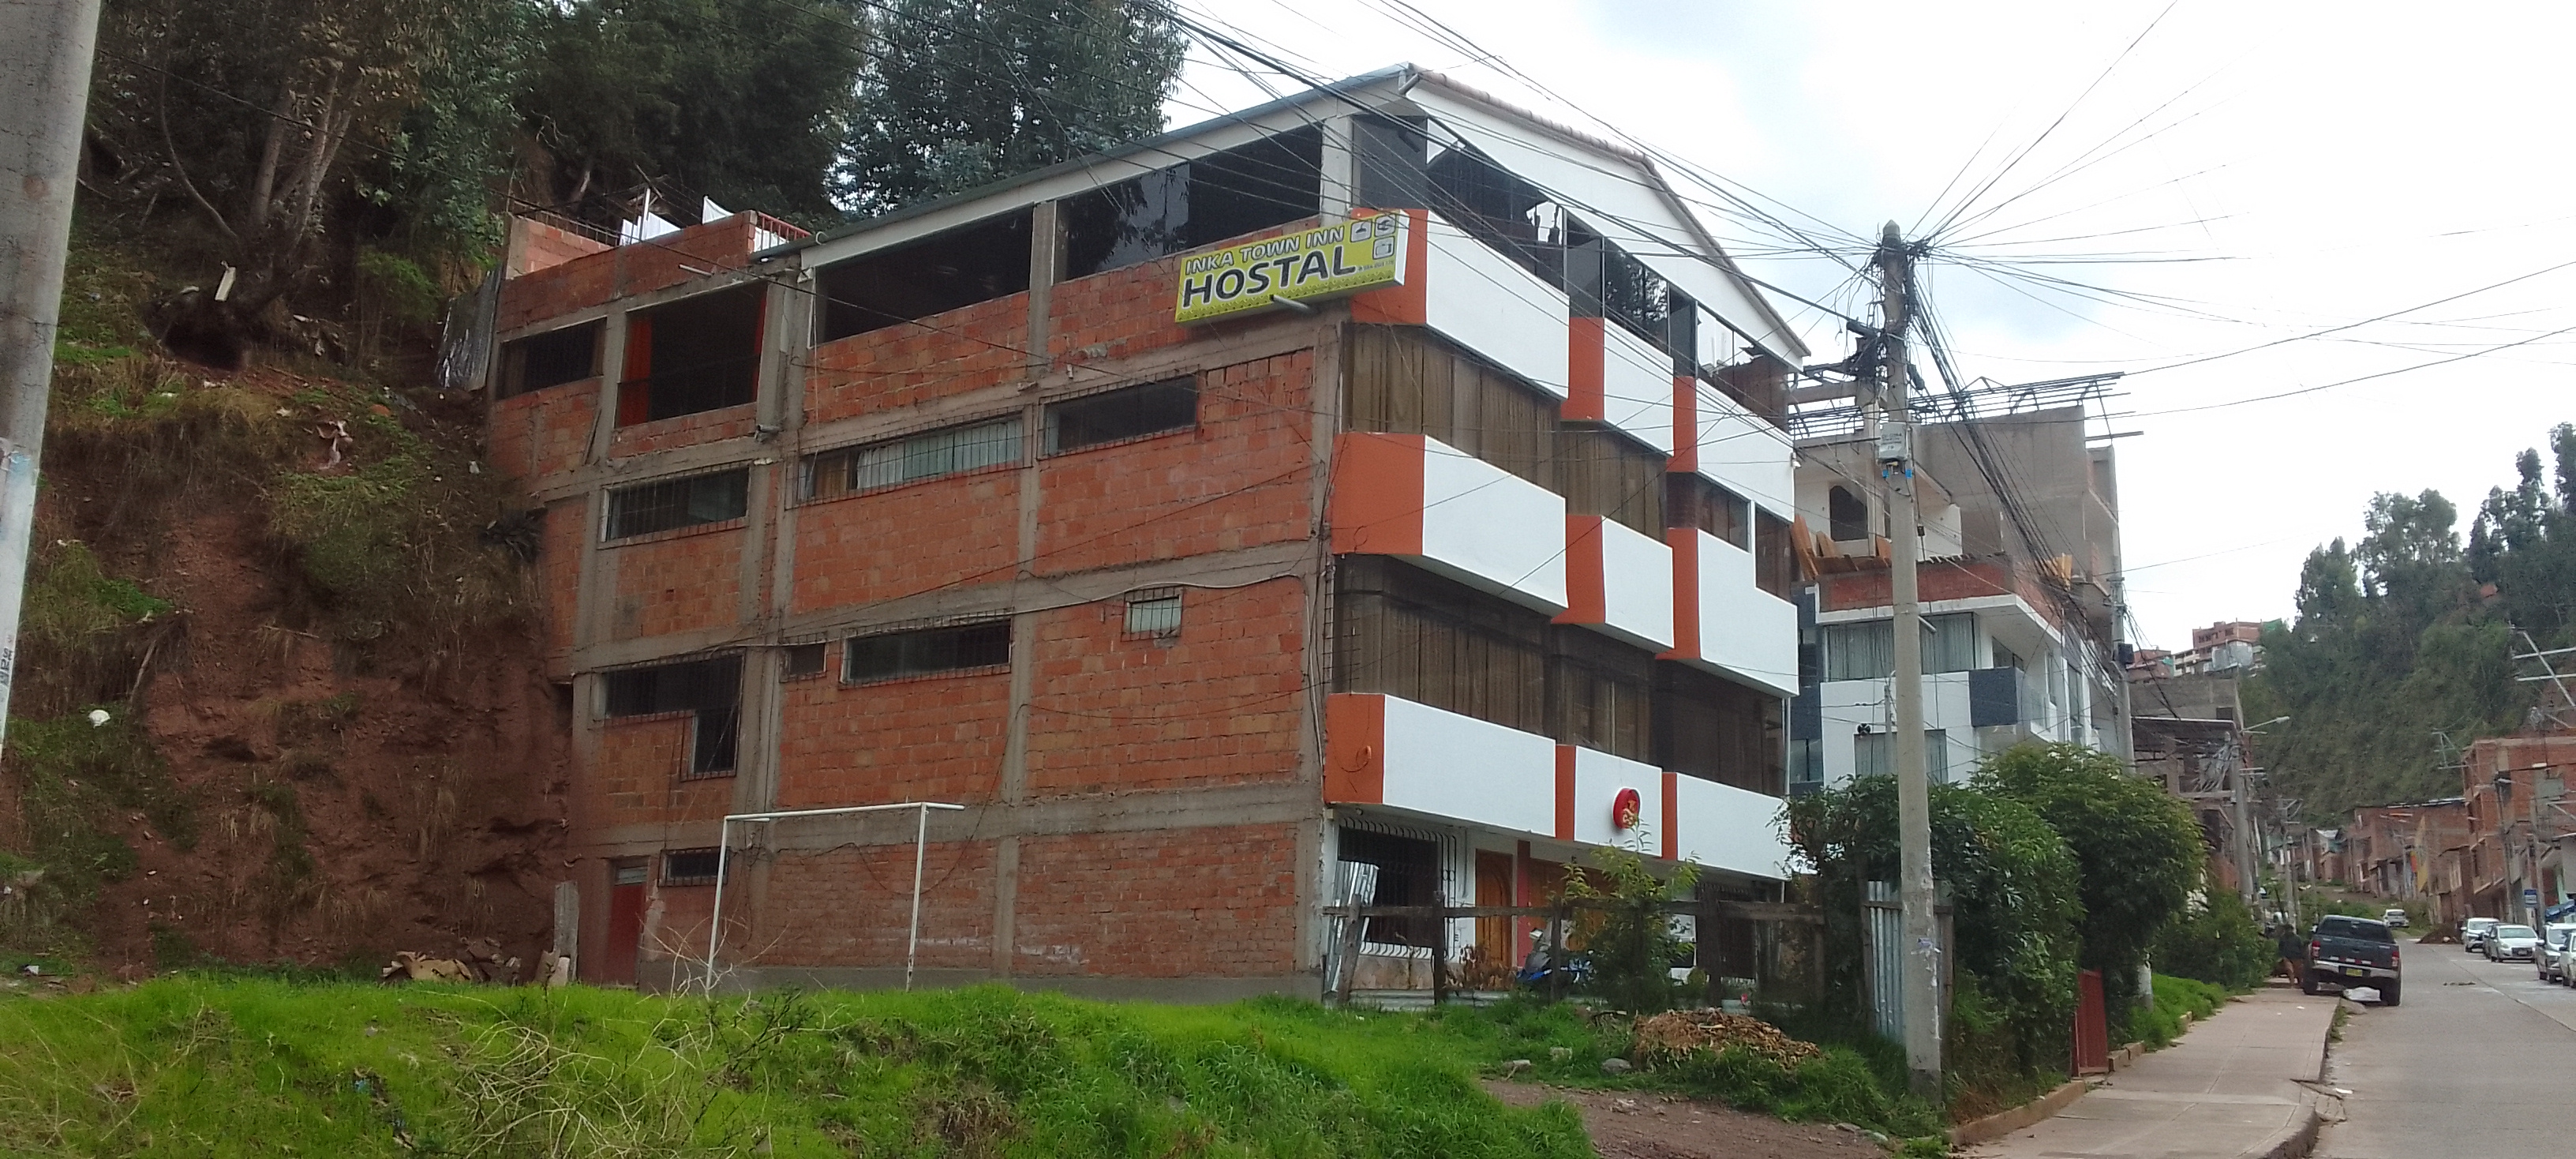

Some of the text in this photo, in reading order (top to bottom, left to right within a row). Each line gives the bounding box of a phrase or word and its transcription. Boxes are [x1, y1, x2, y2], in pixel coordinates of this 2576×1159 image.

[1182, 246, 1356, 309] HOSTAL
[1185, 226, 1345, 275] INKA TOWN INN
